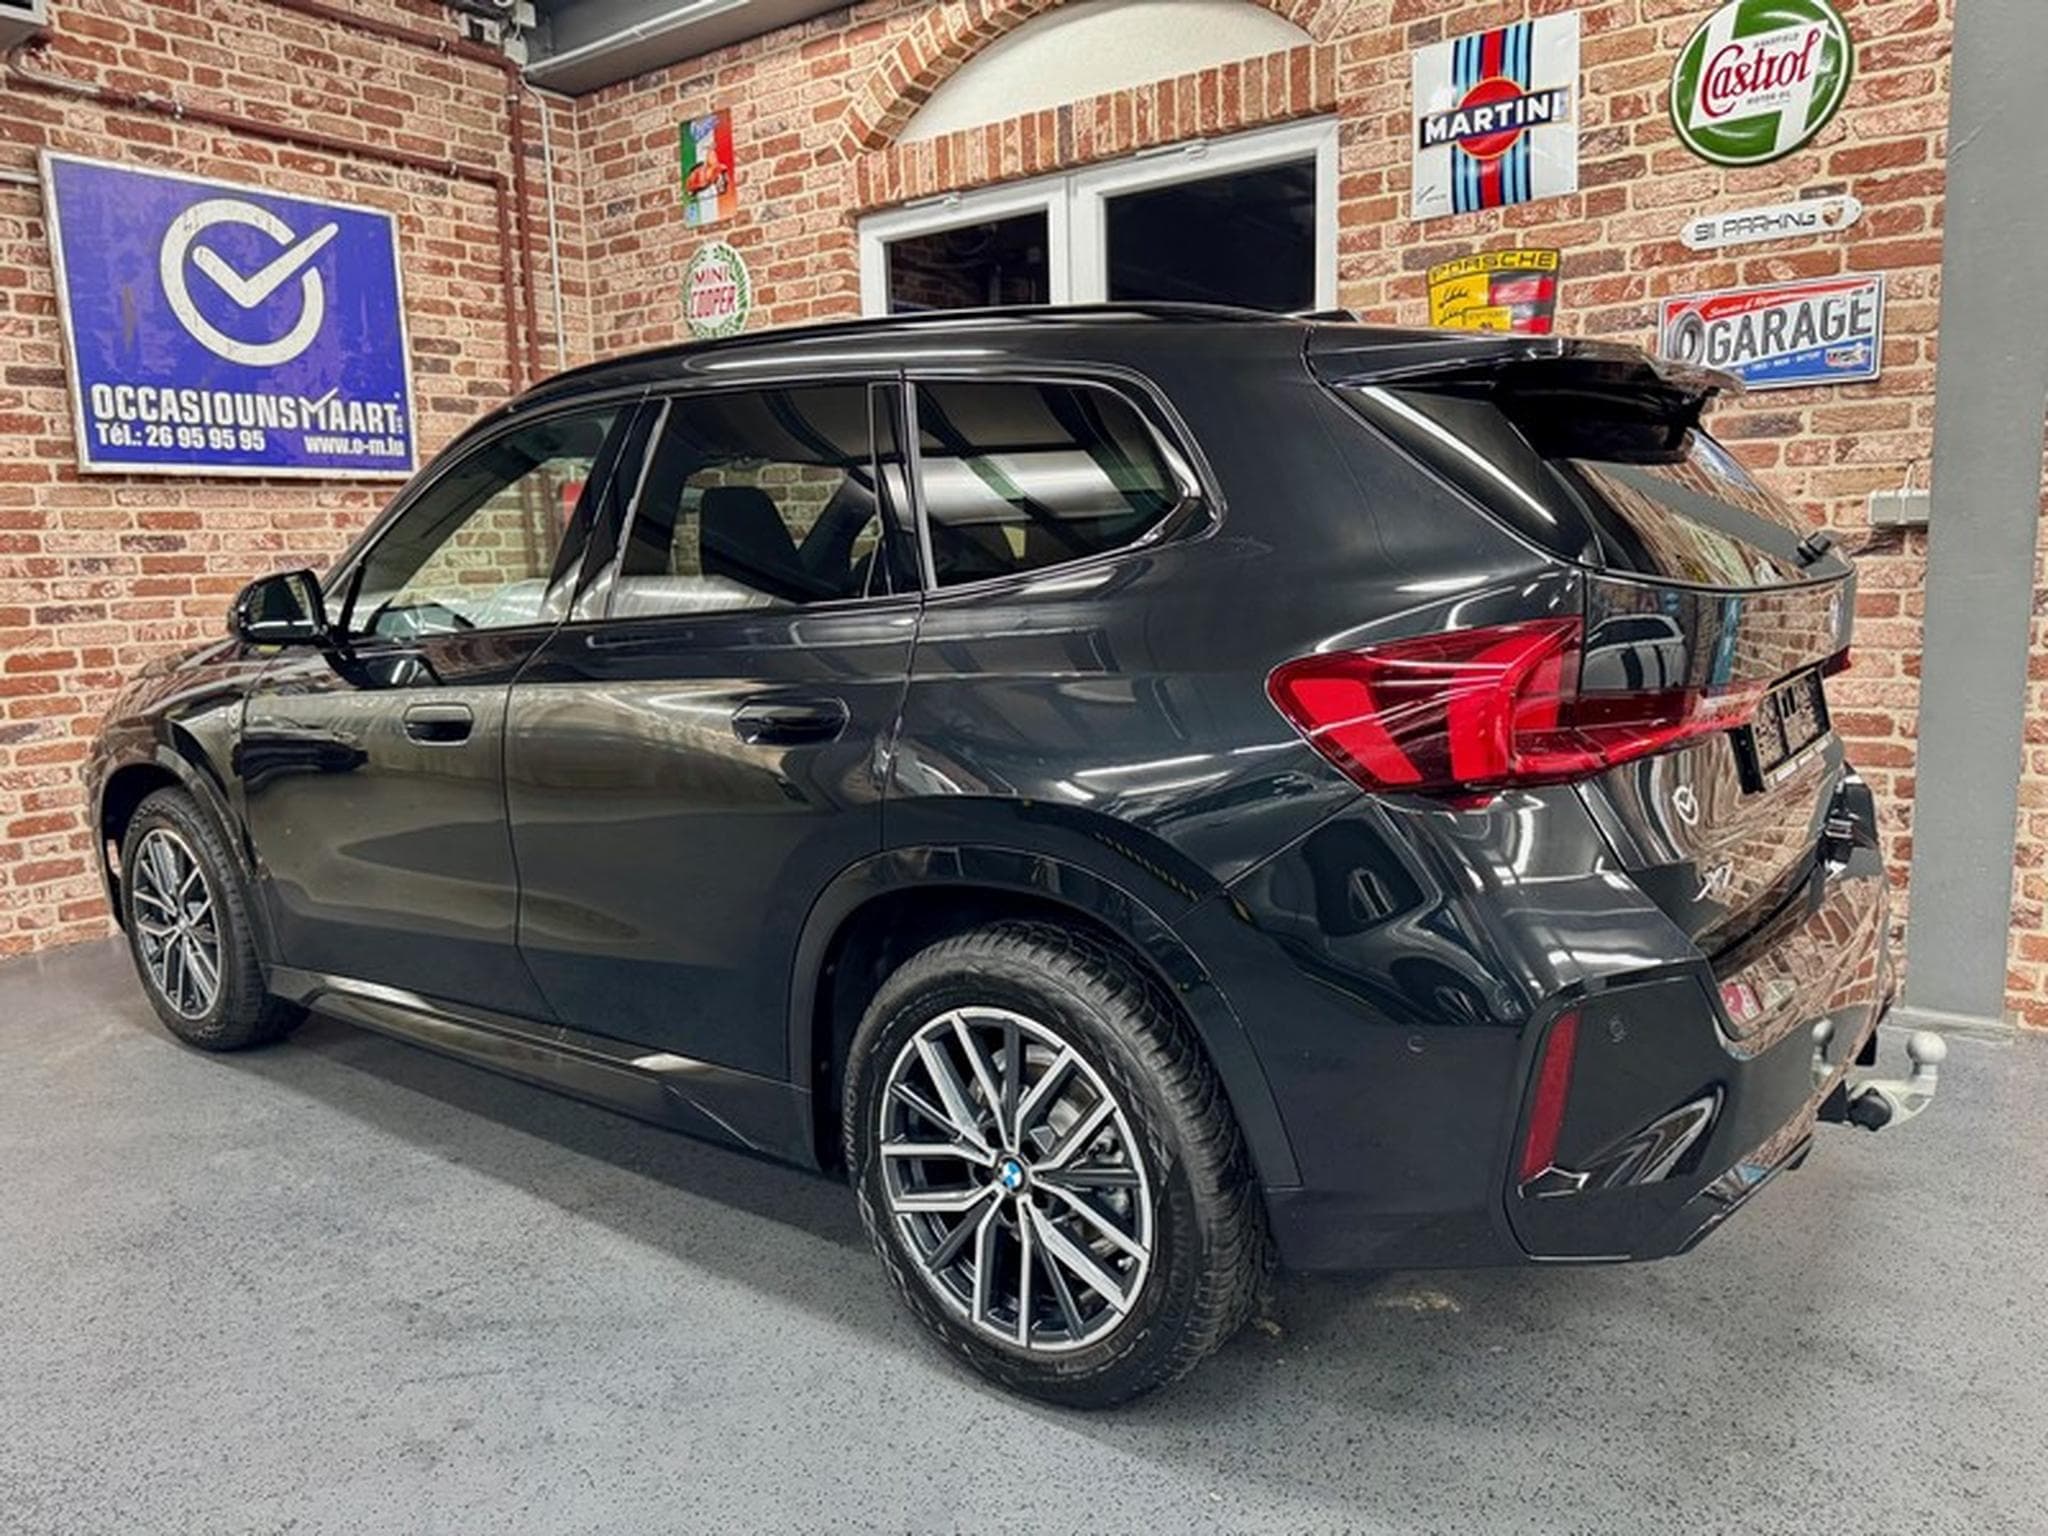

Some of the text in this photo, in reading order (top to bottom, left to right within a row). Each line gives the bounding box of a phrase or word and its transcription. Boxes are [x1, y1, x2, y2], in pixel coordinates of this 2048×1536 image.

[1701, 28, 1822, 118] Castrol
[1425, 91, 1561, 144] MARTINI
[1722, 211, 1816, 238] PARKING
[695, 264, 729, 284] MINI
[1431, 252, 1553, 280] PORSCHE
[1706, 288, 1874, 367] GARAGE
[95, 421, 266, 452] Tél.: 26 95 95 95
